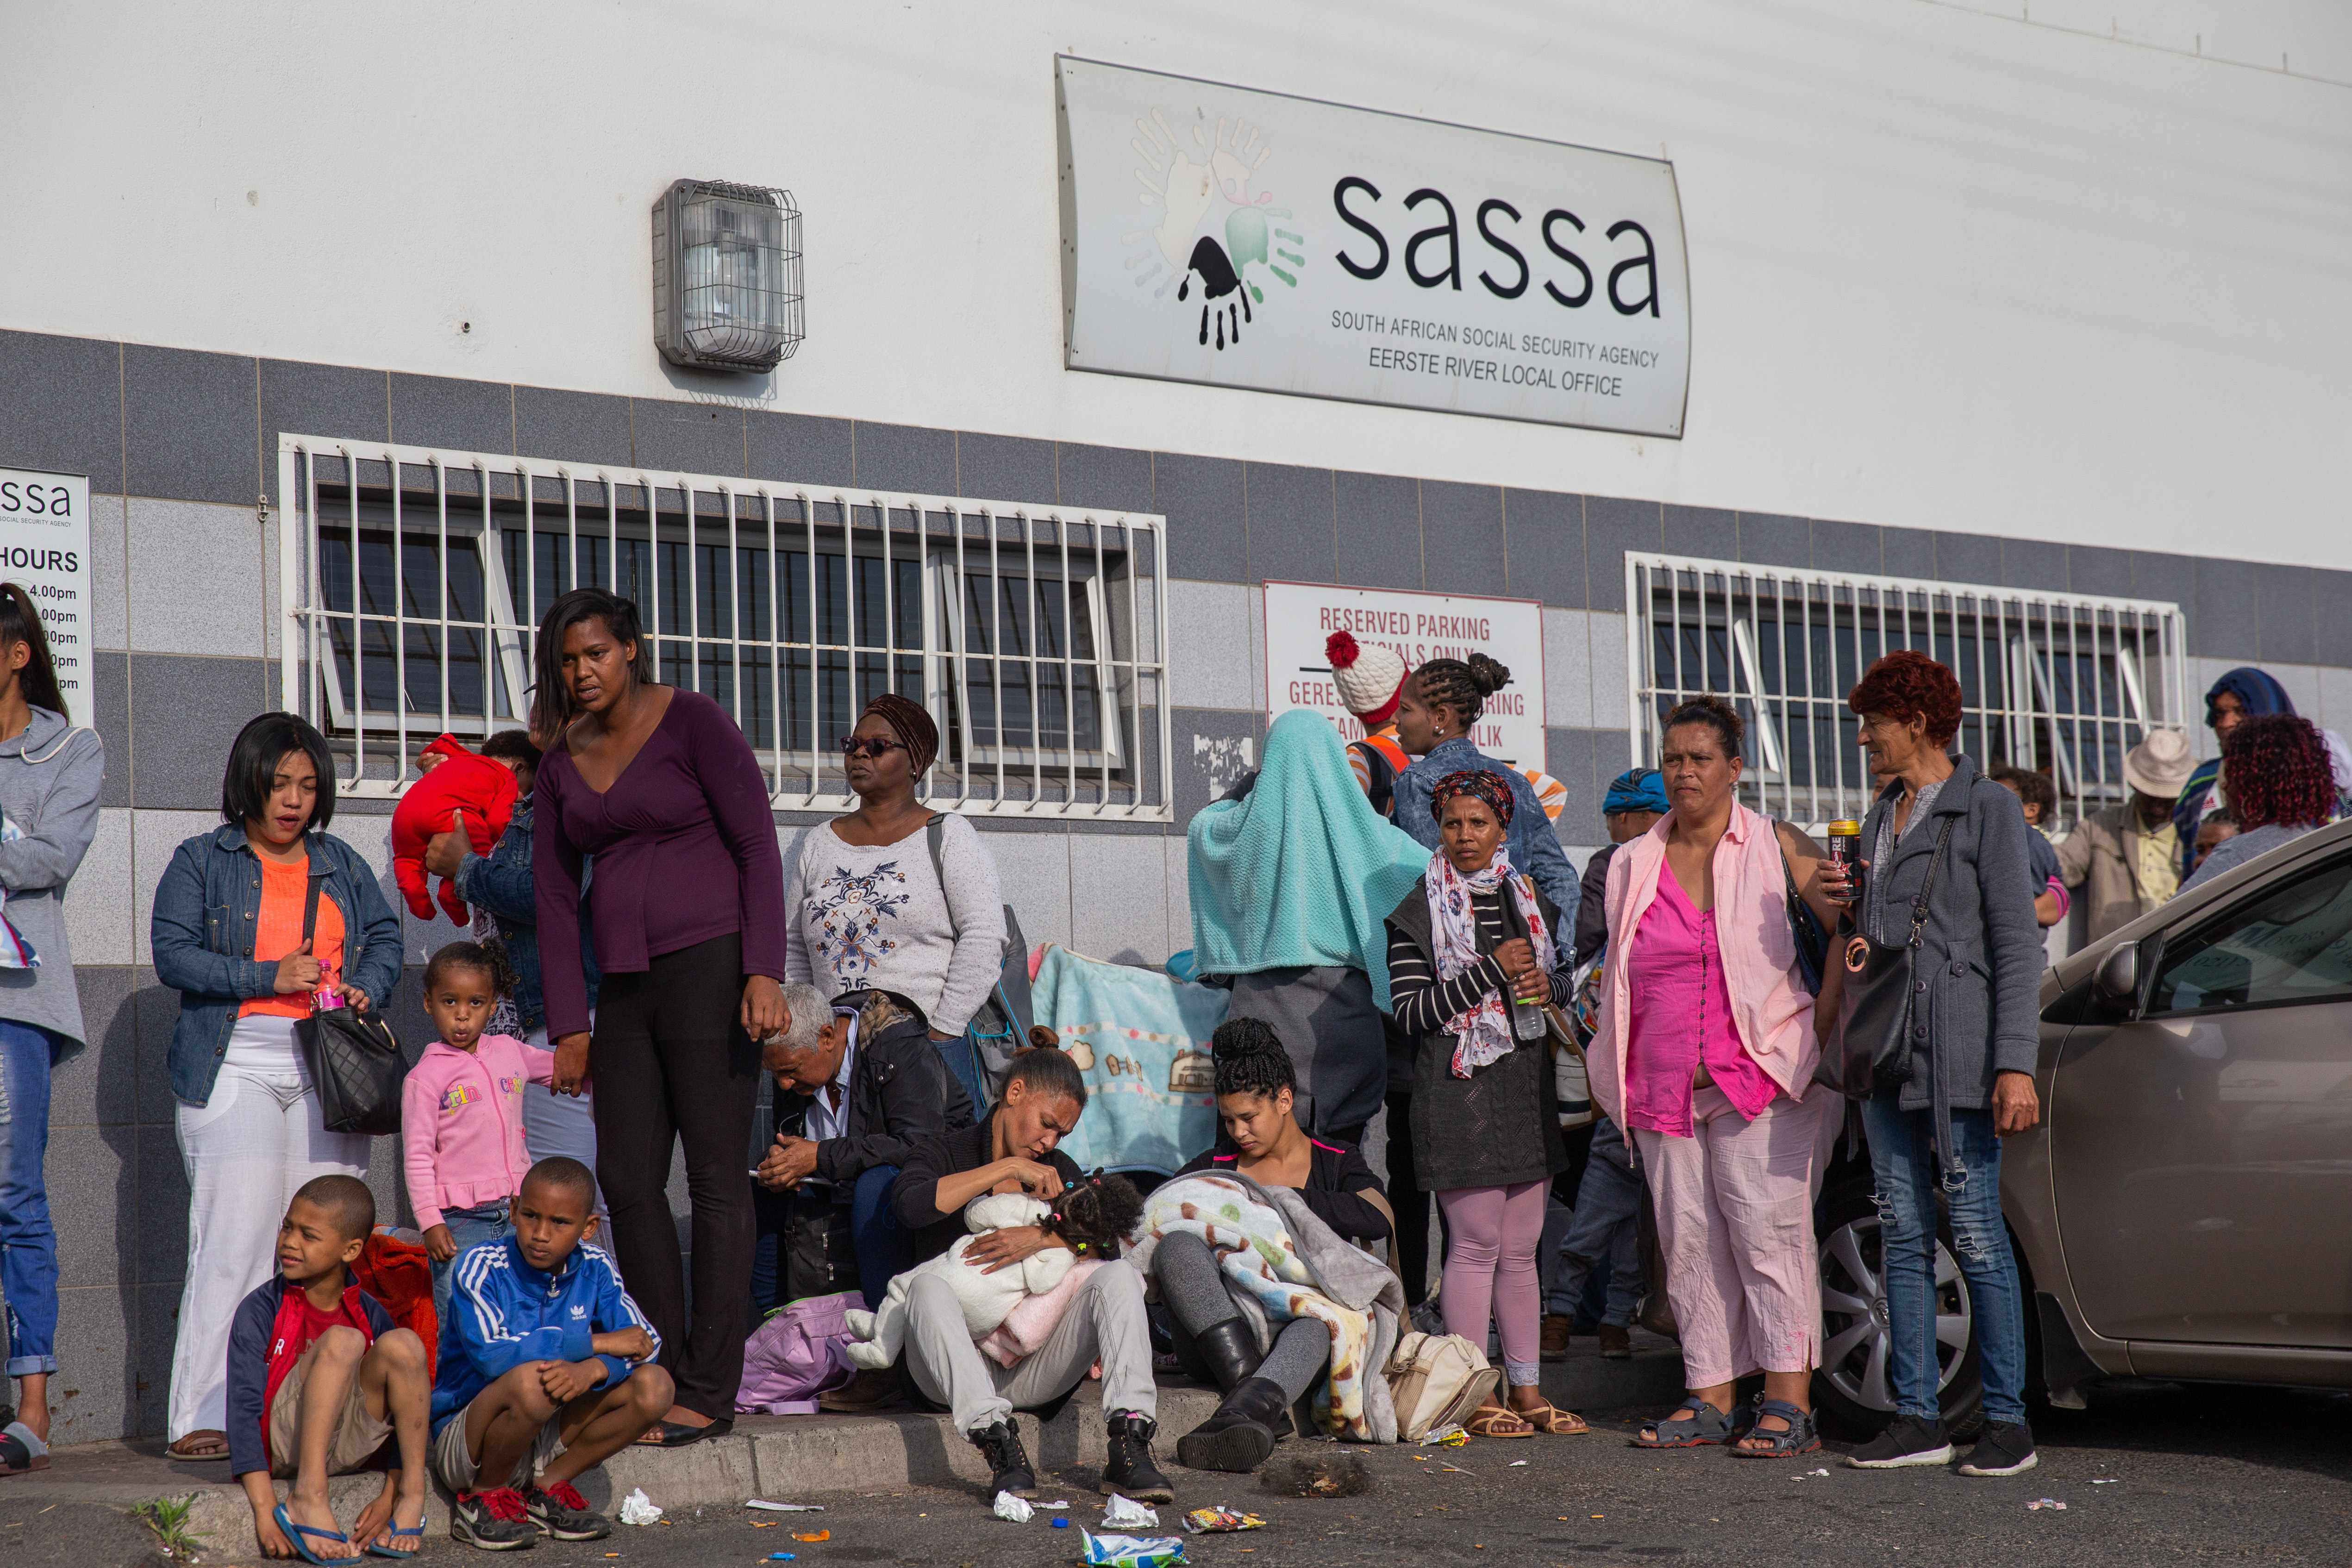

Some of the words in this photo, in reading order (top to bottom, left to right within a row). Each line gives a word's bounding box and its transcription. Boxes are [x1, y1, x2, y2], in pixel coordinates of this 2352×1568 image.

[1333, 175, 1661, 319] sassa
[1332, 310, 1385, 334] SOUTH
[1390, 318, 1457, 343] AFRICAN
[1462, 326, 1517, 351] SOCIAL
[1521, 334, 1595, 361] SECURITY
[1599, 345, 1659, 369] AGENCY
[1369, 347, 1440, 375] EERSTE
[1445, 356, 1498, 382] RIVER
[1502, 363, 1557, 389] LOCAL
[1561, 370, 1622, 397] OFFICE
[30, 584, 76, 601] 4.00pm
[1320, 607, 1410, 635] RESERVED
[1417, 614, 1490, 641] PARKING
